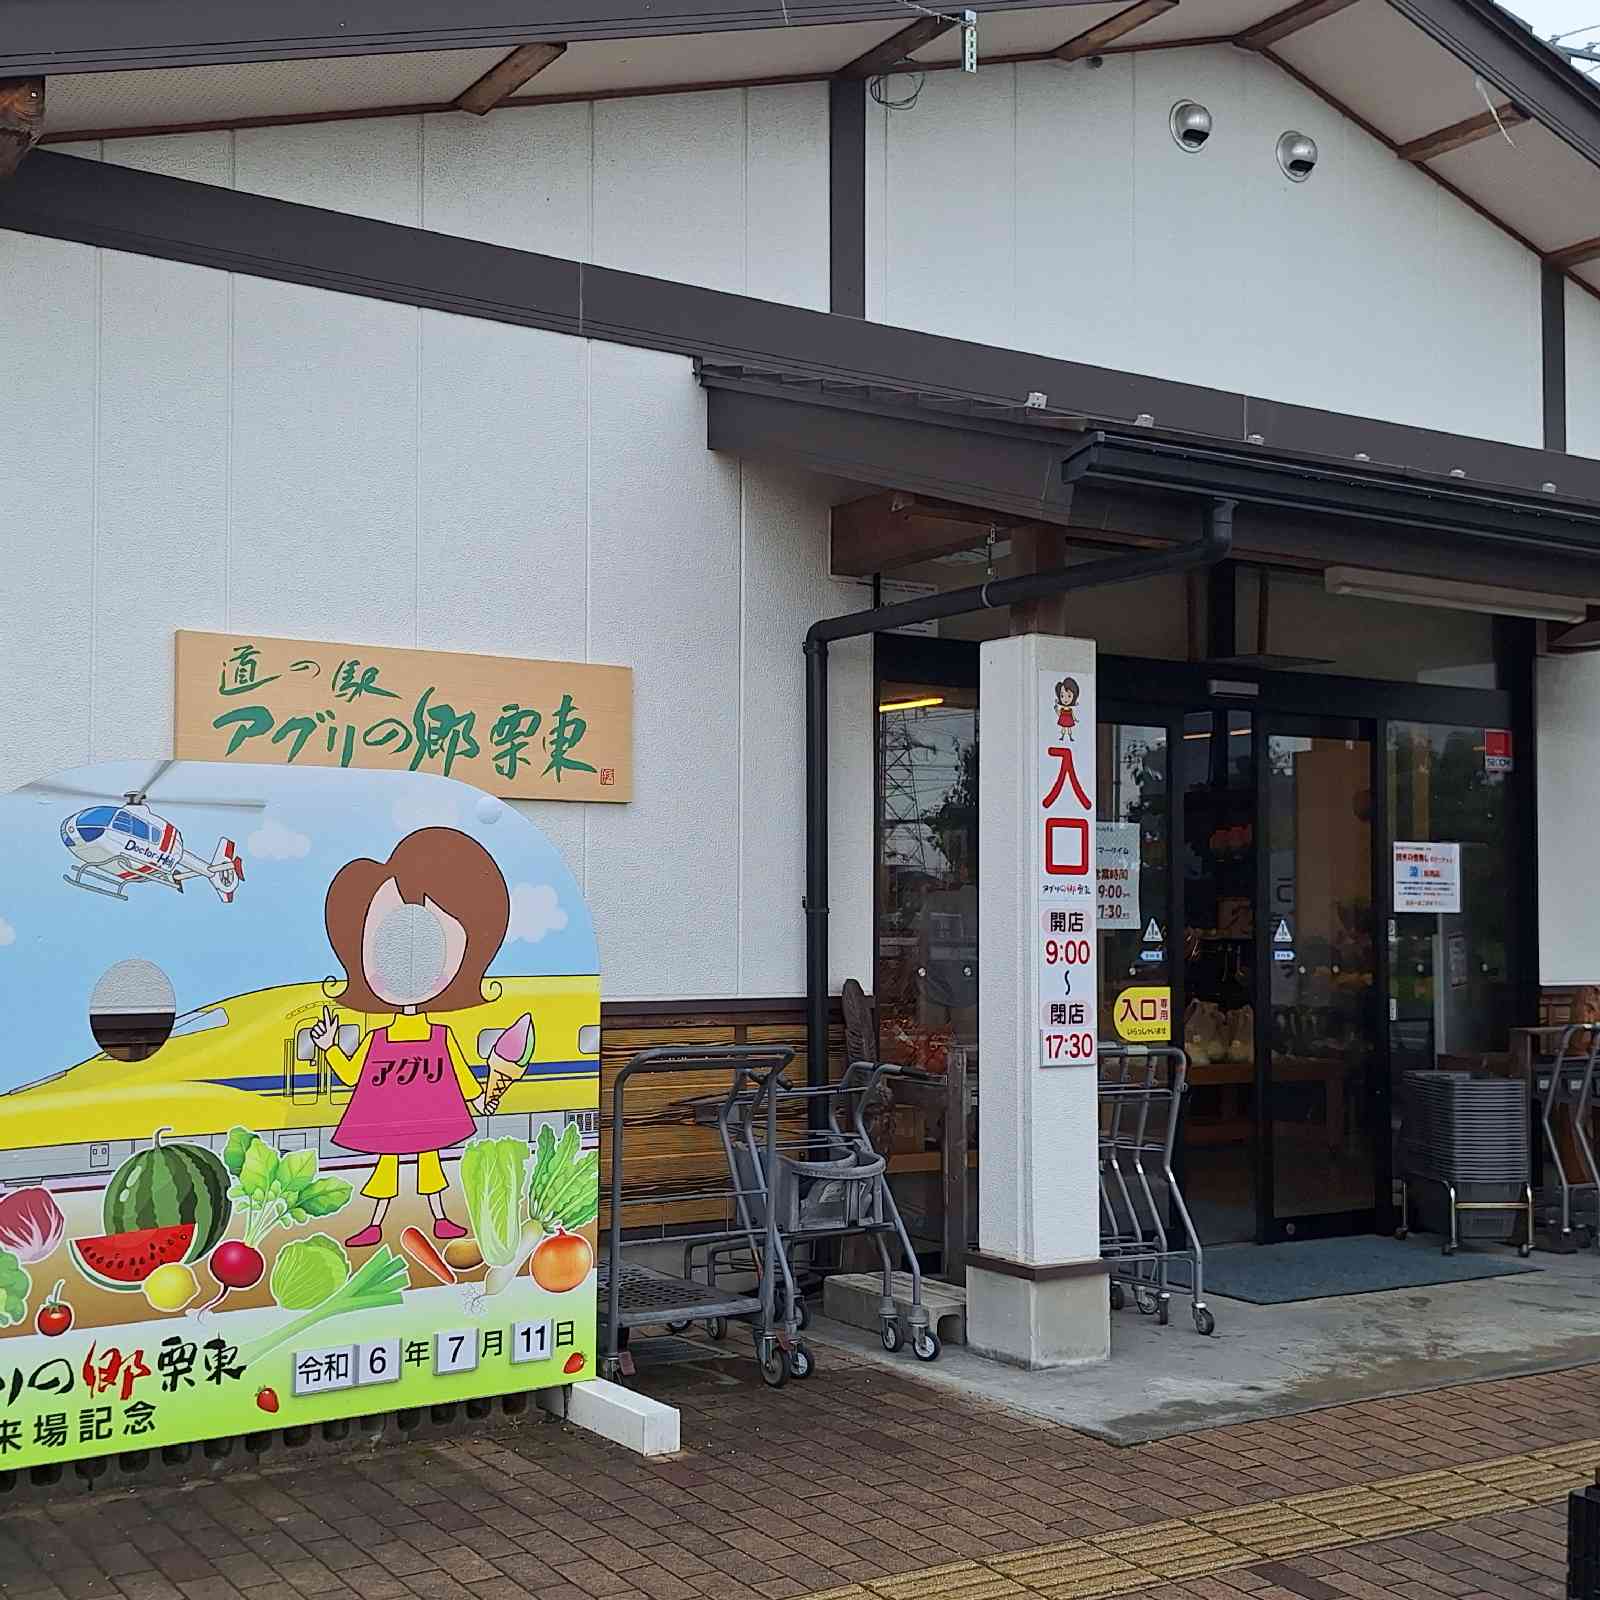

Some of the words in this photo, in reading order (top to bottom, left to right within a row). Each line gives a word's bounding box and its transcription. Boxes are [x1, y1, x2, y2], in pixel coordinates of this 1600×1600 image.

[218, 645, 401, 703] 道の駅
[212, 687, 598, 783] アグリの郷栗東
[1042, 746, 1092, 875] 入口
[1050, 912, 1084, 933] 開店
[1045, 940, 1090, 965] 9:00
[1050, 1003, 1084, 1025] 閉店
[1119, 998, 1157, 1022] 入口
[1045, 1033, 1093, 1060] 17:30
[371, 1056, 444, 1087] アグリ
[0, 1400, 157, 1451] 来場記念
